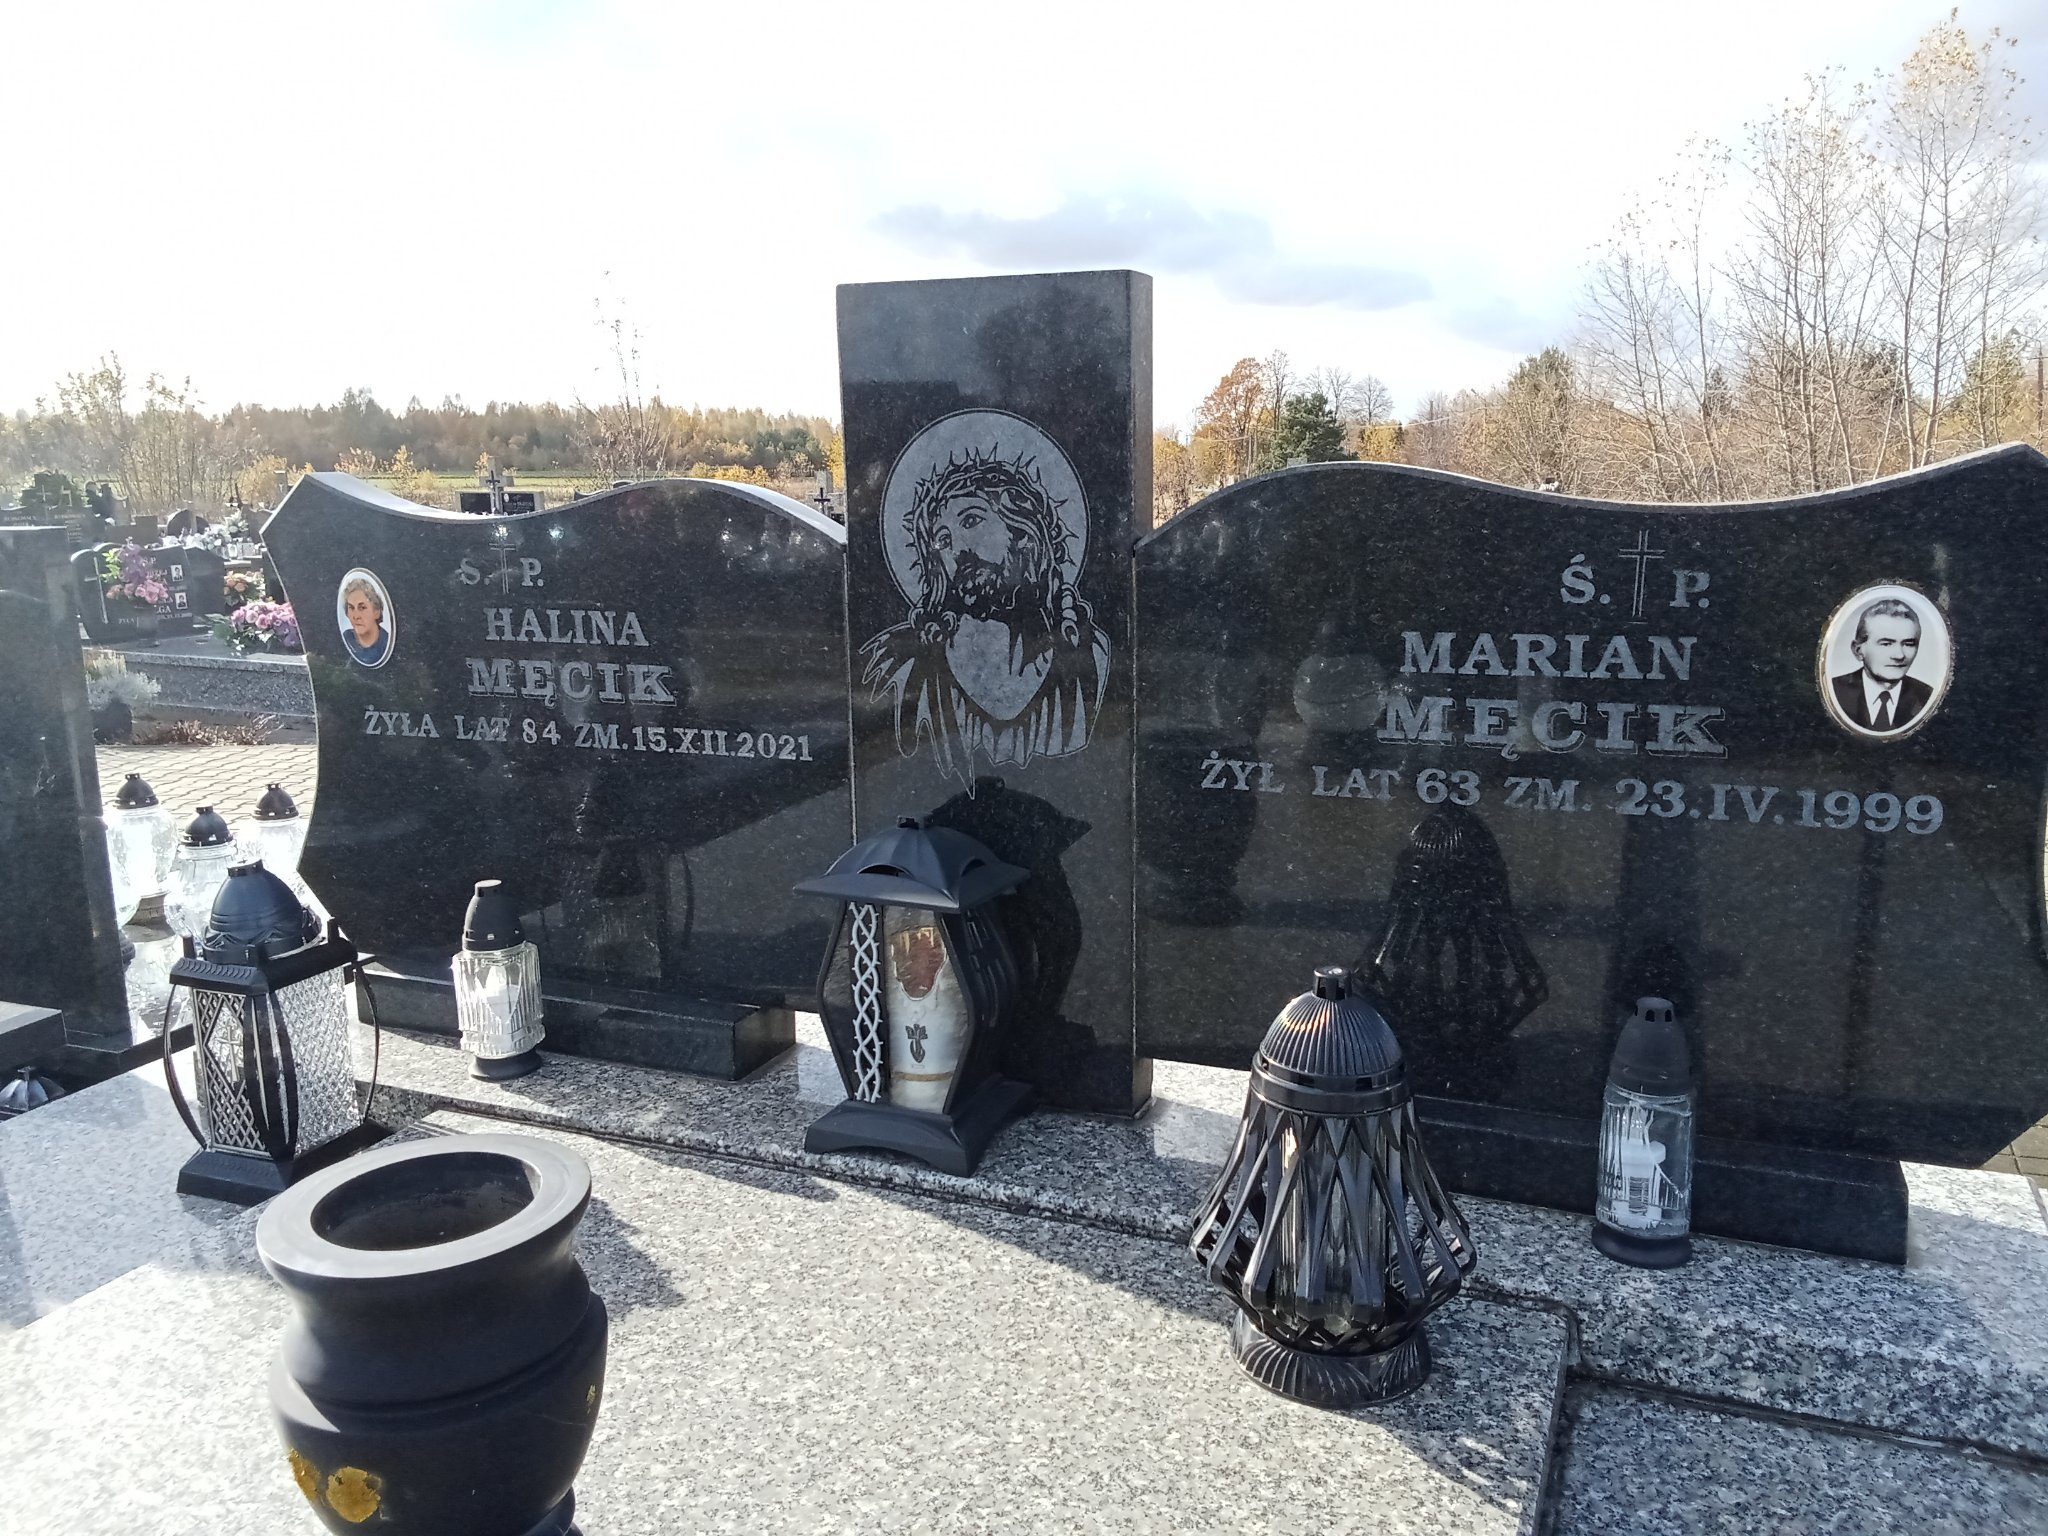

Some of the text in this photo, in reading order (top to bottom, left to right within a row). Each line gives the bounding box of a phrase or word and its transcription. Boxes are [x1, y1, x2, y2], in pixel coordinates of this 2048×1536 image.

[519, 557, 544, 587] P.
[1560, 553, 1710, 609] Ś. P.
[483, 607, 650, 648] HALINA
[1400, 631, 1698, 681] MARIAN
[465, 657, 677, 710] MĘCIK
[364, 704, 440, 738] ŻYŁA
[454, 715, 510, 742] LAT
[522, 718, 561, 745] 84
[1376, 696, 1728, 761] MĘCIK
[1200, 750, 1945, 836] ŻYŁ LAT 63 ZM. 23.IV.1999
